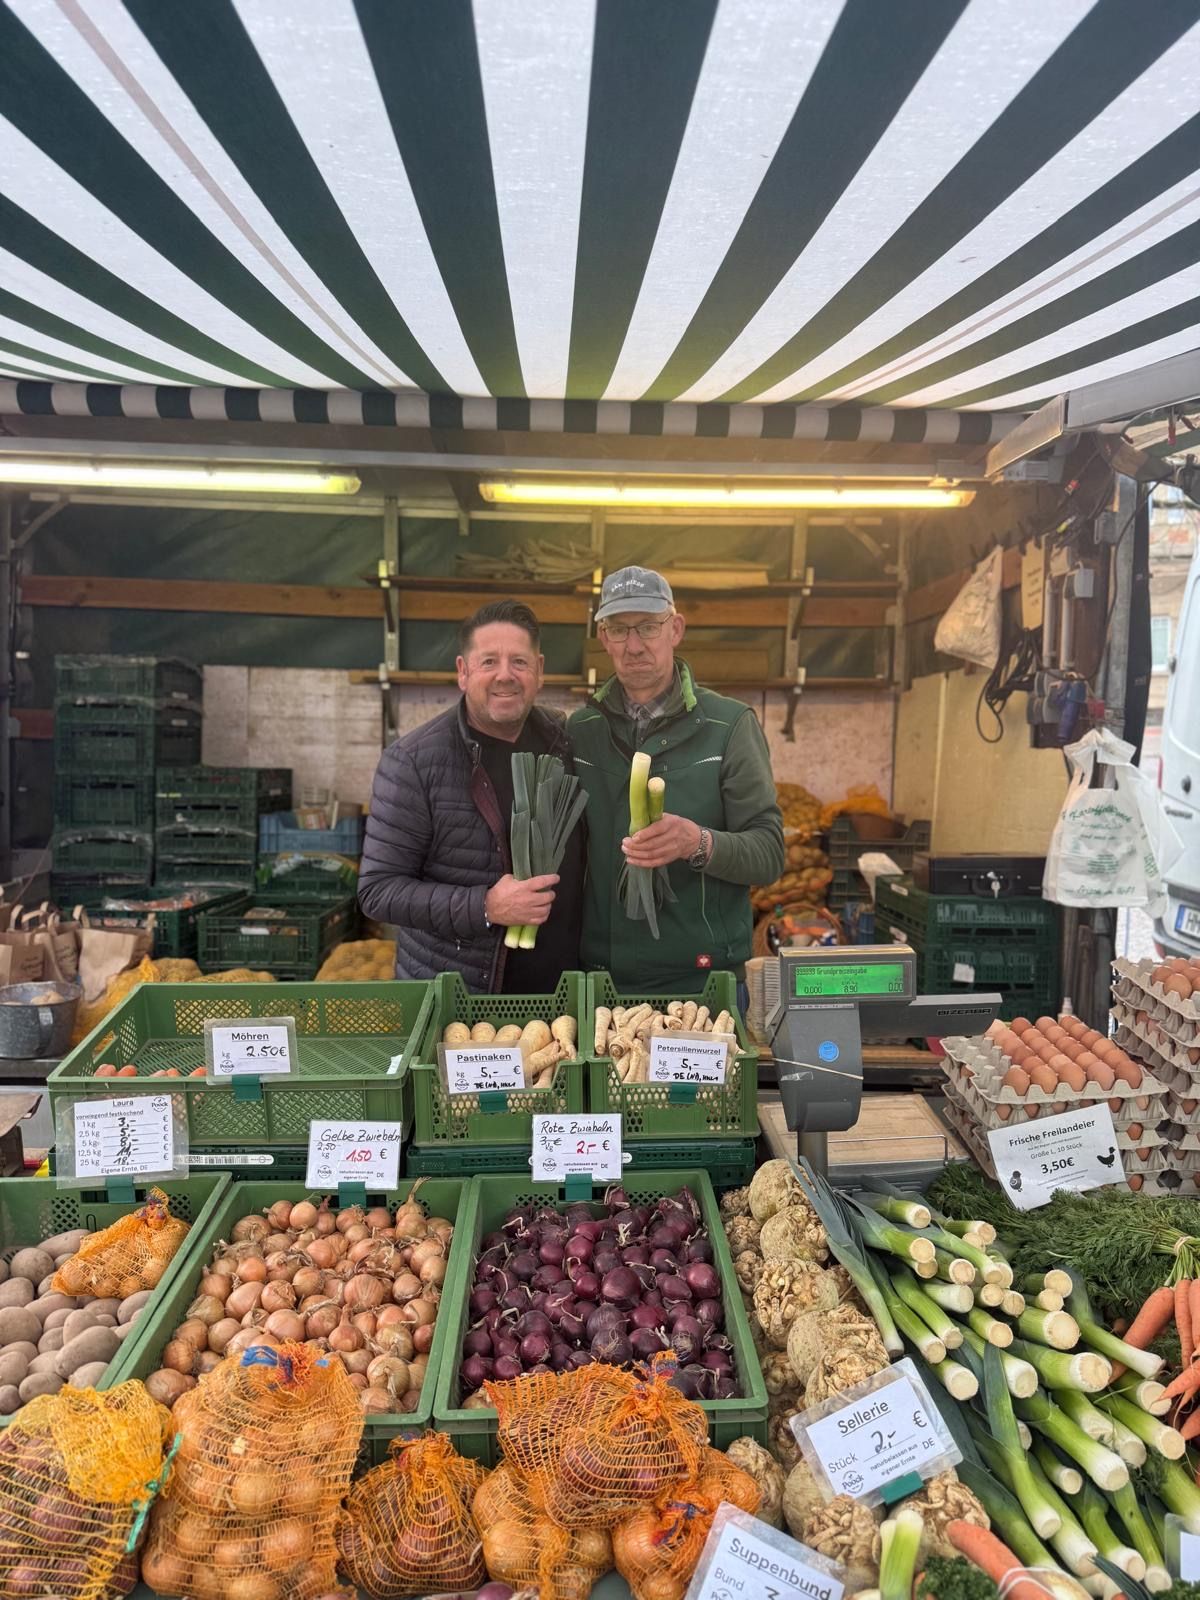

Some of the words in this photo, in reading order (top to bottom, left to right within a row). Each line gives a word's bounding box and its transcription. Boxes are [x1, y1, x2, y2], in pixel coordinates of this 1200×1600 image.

[937, 1008, 992, 1016] BIZERBA
[231, 1032, 269, 1041] Möhren
[222, 1050, 231, 1059] kg
[657, 1044, 721, 1056] Petersilienwurzel
[457, 1053, 512, 1062] Pastinaken
[658, 1059, 667, 1067] kg
[715, 1060, 724, 1070] €
[513, 1065, 521, 1075] €
[673, 1072, 685, 1080] DE
[112, 1099, 134, 1107] Laura
[76, 1112, 108, 1120] vorwiegend
[109, 1109, 144, 1118] festkochend
[163, 1115, 168, 1123] €
[79, 1130, 90, 1138] 2,5
[91, 1130, 100, 1138] kg
[163, 1124, 169, 1132] €
[540, 1120, 565, 1134] Rote
[1009, 1134, 1041, 1147] Frische
[1042, 1120, 1096, 1139] Freilandeier
[88, 1139, 98, 1148] kg
[163, 1134, 169, 1142] €
[320, 1128, 355, 1142] Gelbe
[78, 1149, 91, 1157] 12,5
[163, 1143, 169, 1151] €
[602, 1139, 610, 1151] €
[1030, 1150, 1050, 1160] Größe
[1066, 1142, 1083, 1152] Stück
[80, 1159, 89, 1167] 25
[163, 1153, 169, 1161] €
[345, 1148, 372, 1163] 1,50
[379, 1148, 388, 1160] €
[1040, 1156, 1075, 1175] 3,50€
[837, 1401, 889, 1434] Sellerie
[912, 1409, 928, 1429] €
[922, 1437, 936, 1450] DE
[827, 1452, 858, 1474] Stück
[870, 1448, 908, 1471] naturbelassen
[908, 1443, 918, 1453] aus
[900, 1455, 916, 1466] Ernte
[729, 1537, 832, 1600] Suppenbund
[713, 1567, 745, 1591] Bund
